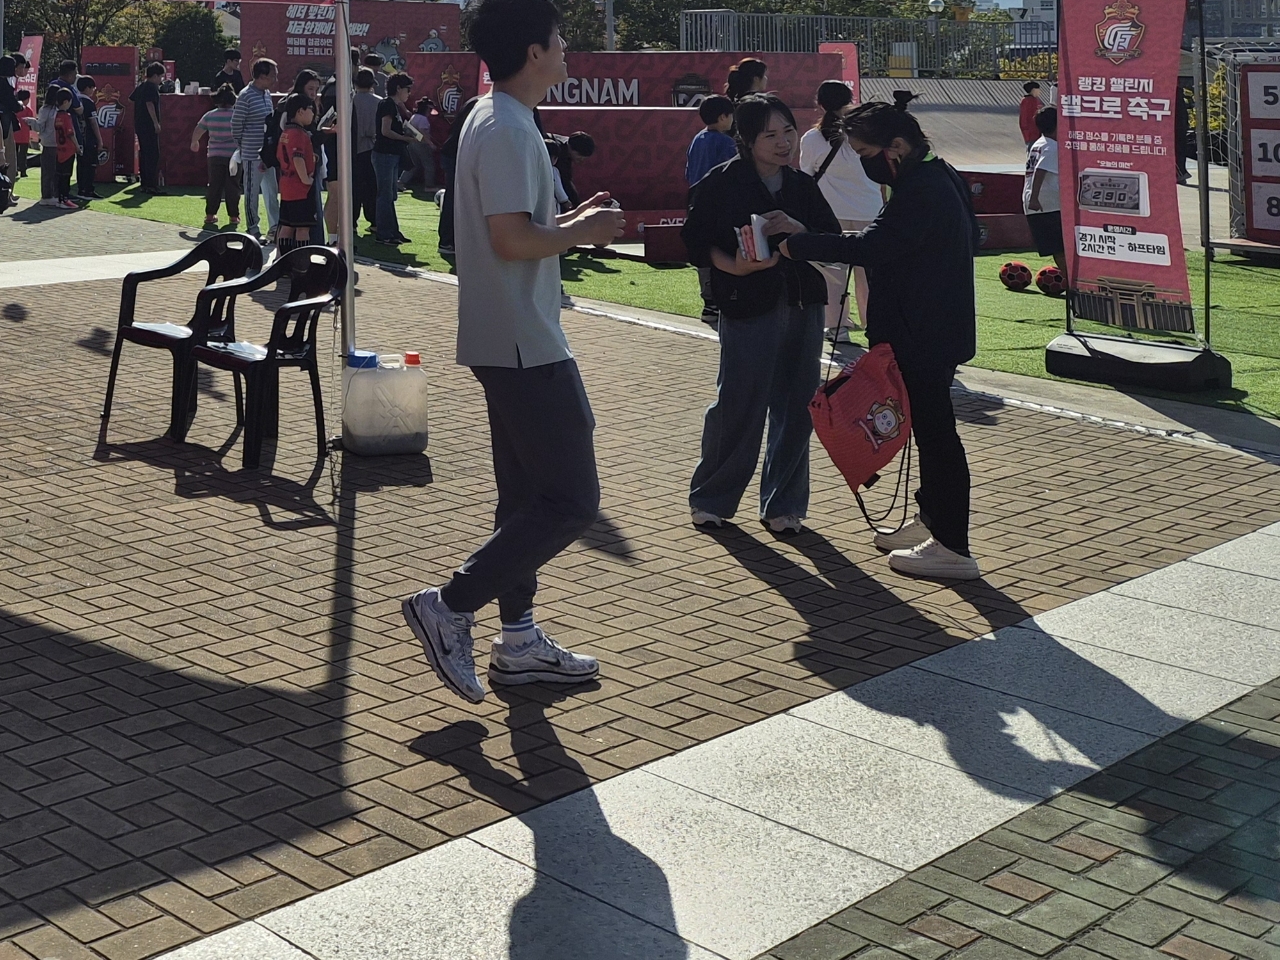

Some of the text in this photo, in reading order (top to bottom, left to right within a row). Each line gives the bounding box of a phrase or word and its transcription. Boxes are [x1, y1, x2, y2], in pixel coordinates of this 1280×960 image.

[285, 4, 309, 19] 헤더
[285, 21, 305, 35] 지금
[1078, 76, 1154, 93] 랭킹 챌린지
[1127, 96, 1172, 121] 축구
[1068, 130, 1163, 145] 해당 점수를 기록한 분들 중
[1065, 141, 1167, 155] 추첨을 통해 경품을 드립니다!
[1107, 225, 1132, 235] 운영시간
[1078, 232, 1117, 245] 경기 시작
[1081, 243, 1105, 254] 2시간
[1106, 245, 1116, 255] 전
[1127, 242, 1166, 255] 하프타임
